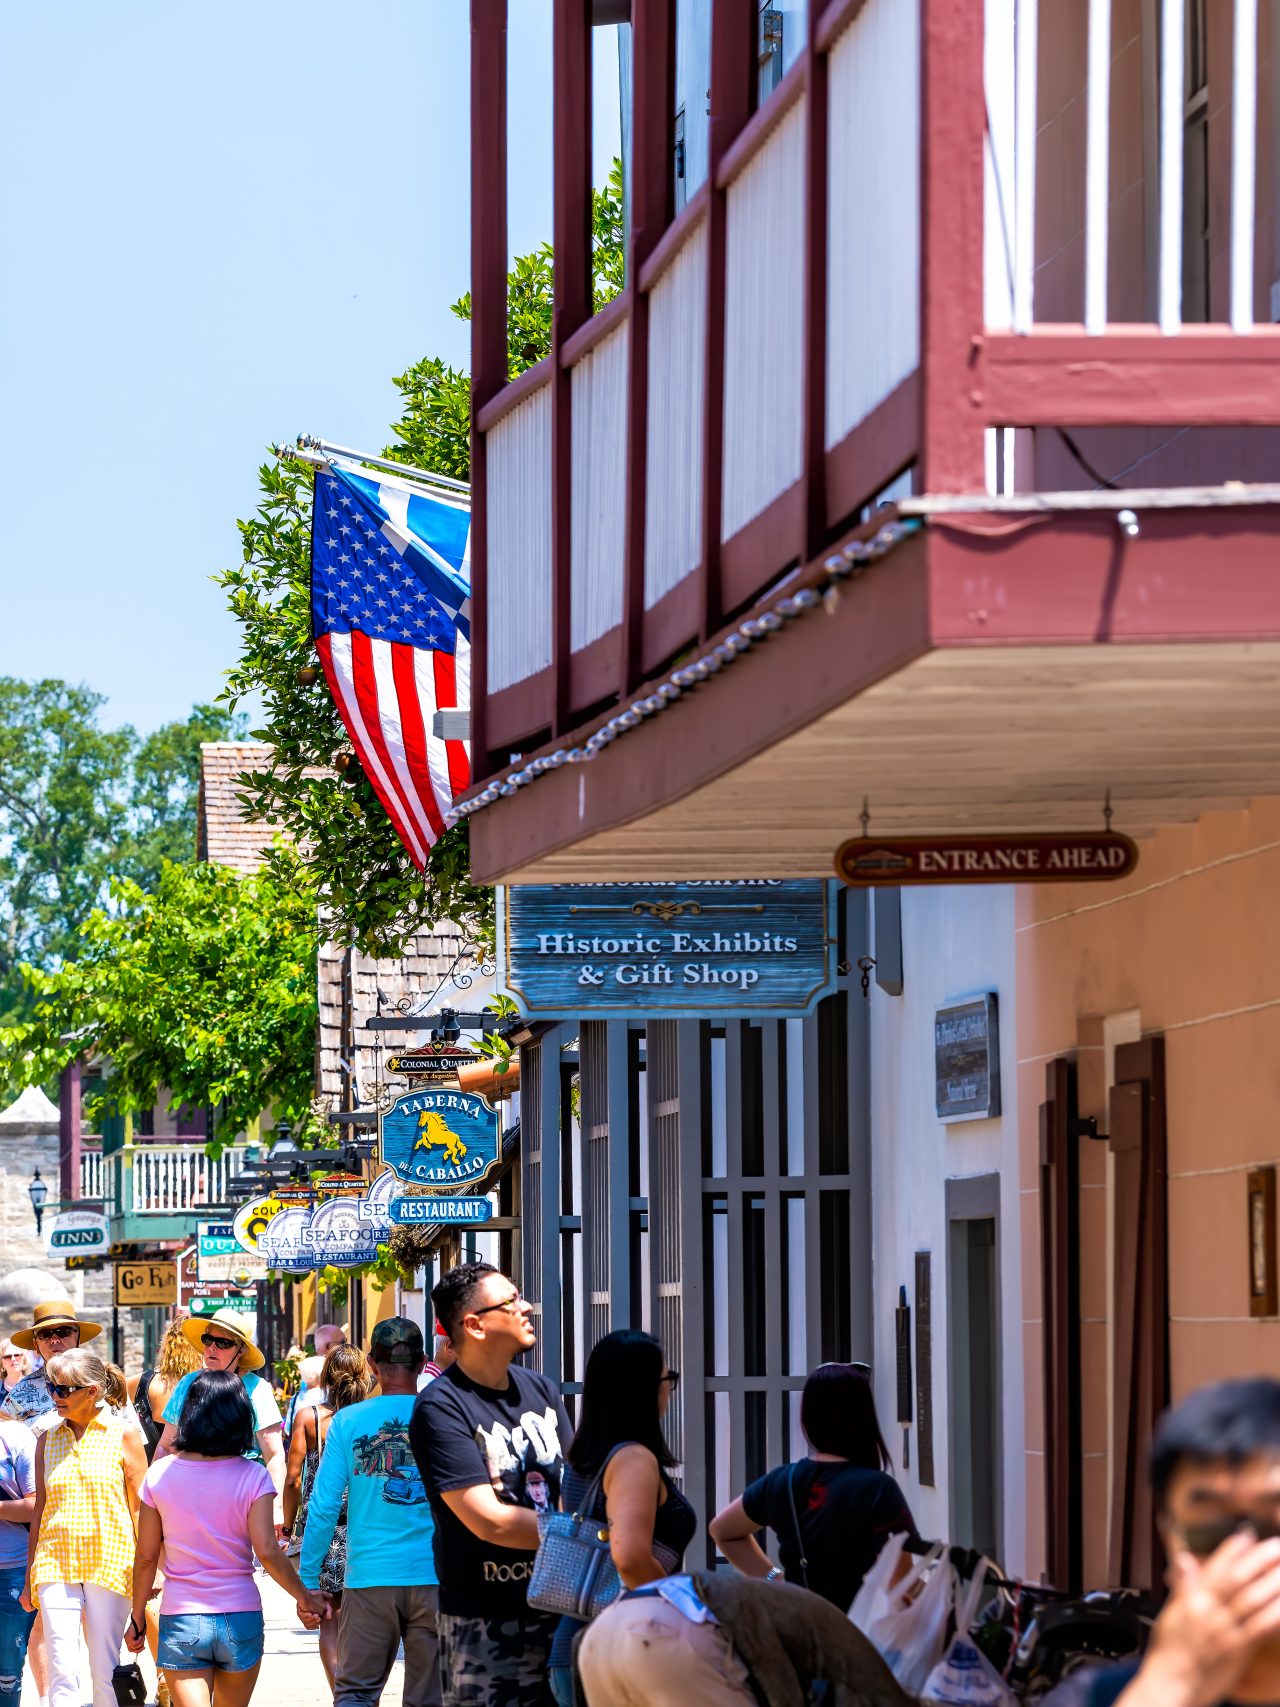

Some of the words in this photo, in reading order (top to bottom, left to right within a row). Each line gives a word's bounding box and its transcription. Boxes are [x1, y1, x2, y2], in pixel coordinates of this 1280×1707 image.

[919, 848, 1041, 872] ENTRANCE
[1046, 847, 1126, 869] AHEAD
[536, 932, 662, 955] Historic
[671, 931, 798, 953] Exhibits
[577, 964, 604, 985] &
[615, 963, 674, 985] Gift
[683, 963, 759, 990] Shop
[400, 1059, 439, 1069] COLONIAL
[398, 1094, 482, 1118] TABERNA
[398, 1160, 414, 1174] DEL
[415, 1155, 484, 1180] CABALLO
[400, 1201, 481, 1218] RESTAURANT
[60, 1231, 95, 1245] INN
[305, 1228, 373, 1242] SEAFOO
[315, 1252, 375, 1261] RESTAURANT
[121, 1269, 144, 1290] Go
